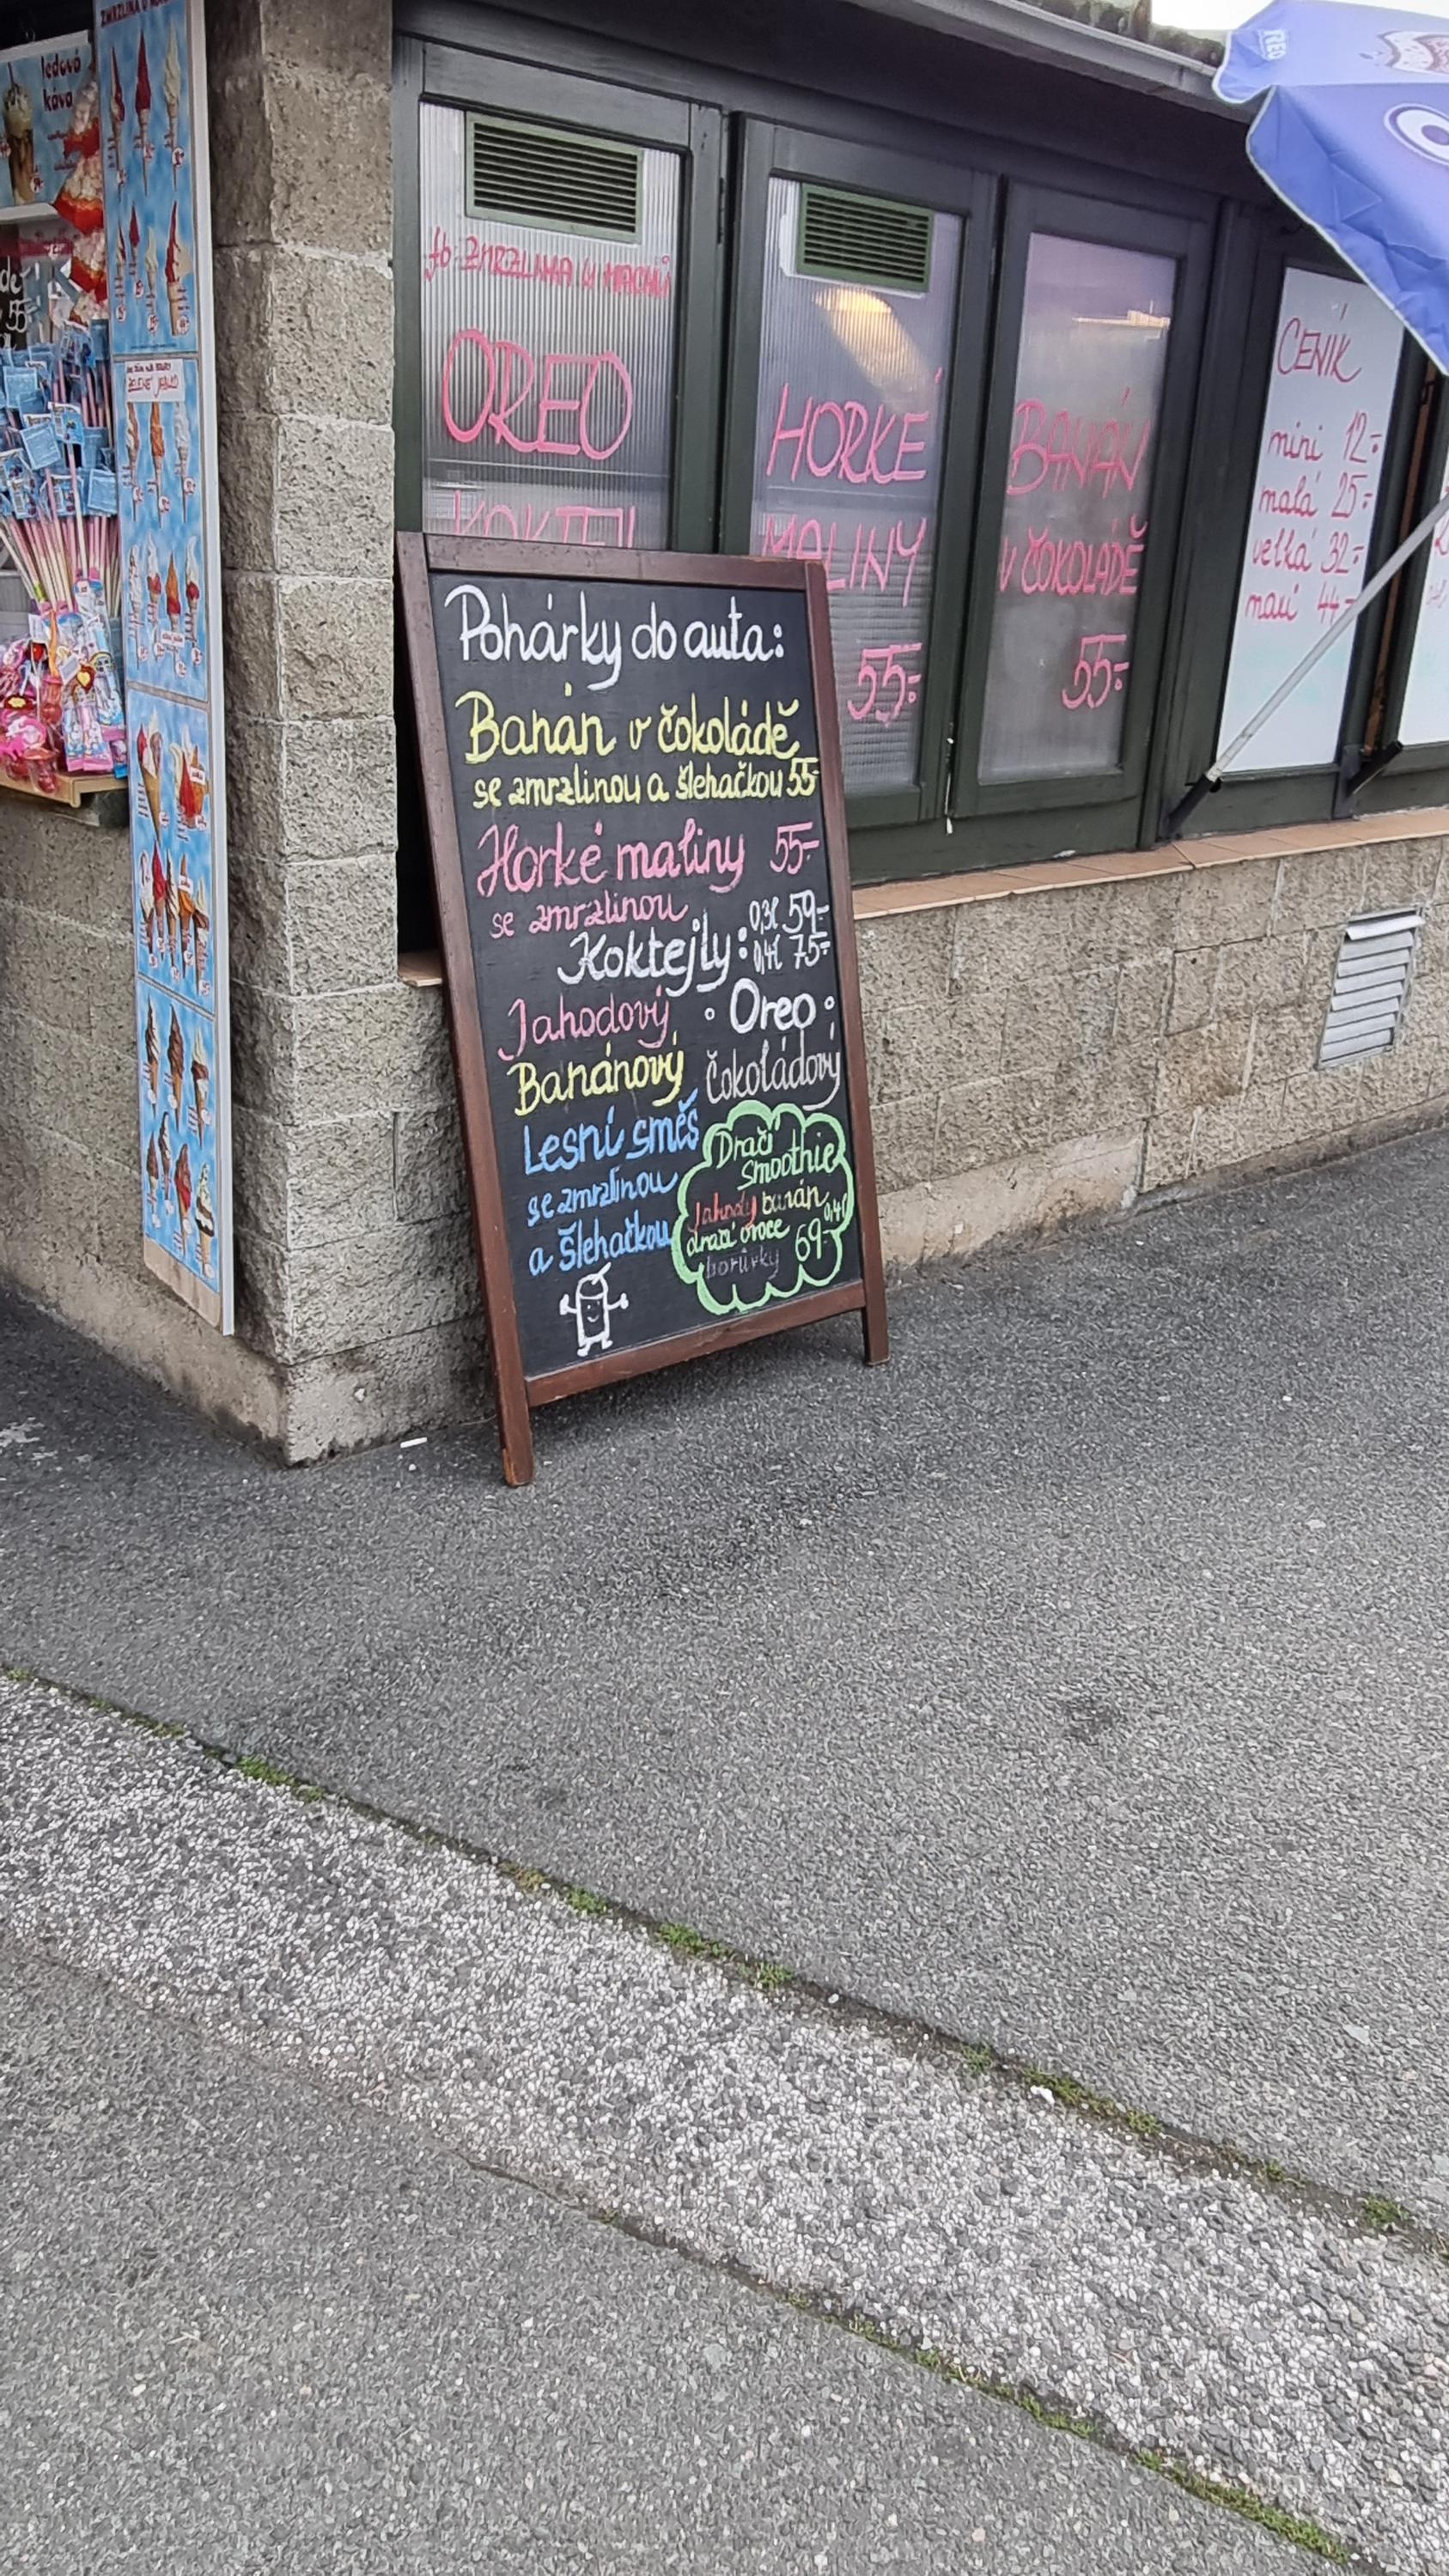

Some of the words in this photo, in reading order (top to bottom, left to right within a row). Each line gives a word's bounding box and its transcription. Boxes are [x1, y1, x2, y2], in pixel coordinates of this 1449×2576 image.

[1276, 302, 1362, 383] CENÍK
[442, 327, 633, 460] OREO
[766, 367, 942, 484] HORKÉ
[1008, 387, 1153, 499] BANÁN
[1268, 422, 1324, 461] mini
[1258, 471, 1322, 518] malá
[1020, 514, 1148, 595] ČOKOLÁDĚ
[1251, 526, 1318, 574] velká
[444, 584, 622, 690] Pohárky
[632, 602, 677, 659] do
[685, 596, 784, 662] auta:
[454, 682, 617, 763] Banán
[629, 717, 652, 750] v
[657, 692, 801, 759] čokoládě
[472, 775, 502, 809] se
[508, 764, 641, 806] zmrzlinou
[647, 772, 670, 801] a
[675, 760, 782, 800] šlehačkou
[477, 820, 607, 897] Horké
[616, 817, 745, 893] maliny
[490, 913, 514, 939] se
[529, 892, 688, 934] zmrzlinou
[557, 908, 748, 997] Koktejly:
[498, 985, 671, 1060] Jahodový
[729, 978, 816, 1034] Oreo
[507, 1031, 685, 1116] Banánový
[523, 1107, 625, 1175] Lesní
[626, 1090, 700, 1159] směs
[527, 1198, 554, 1228] se
[557, 1165, 679, 1213] zmrzlinou
[528, 1247, 554, 1277] a
